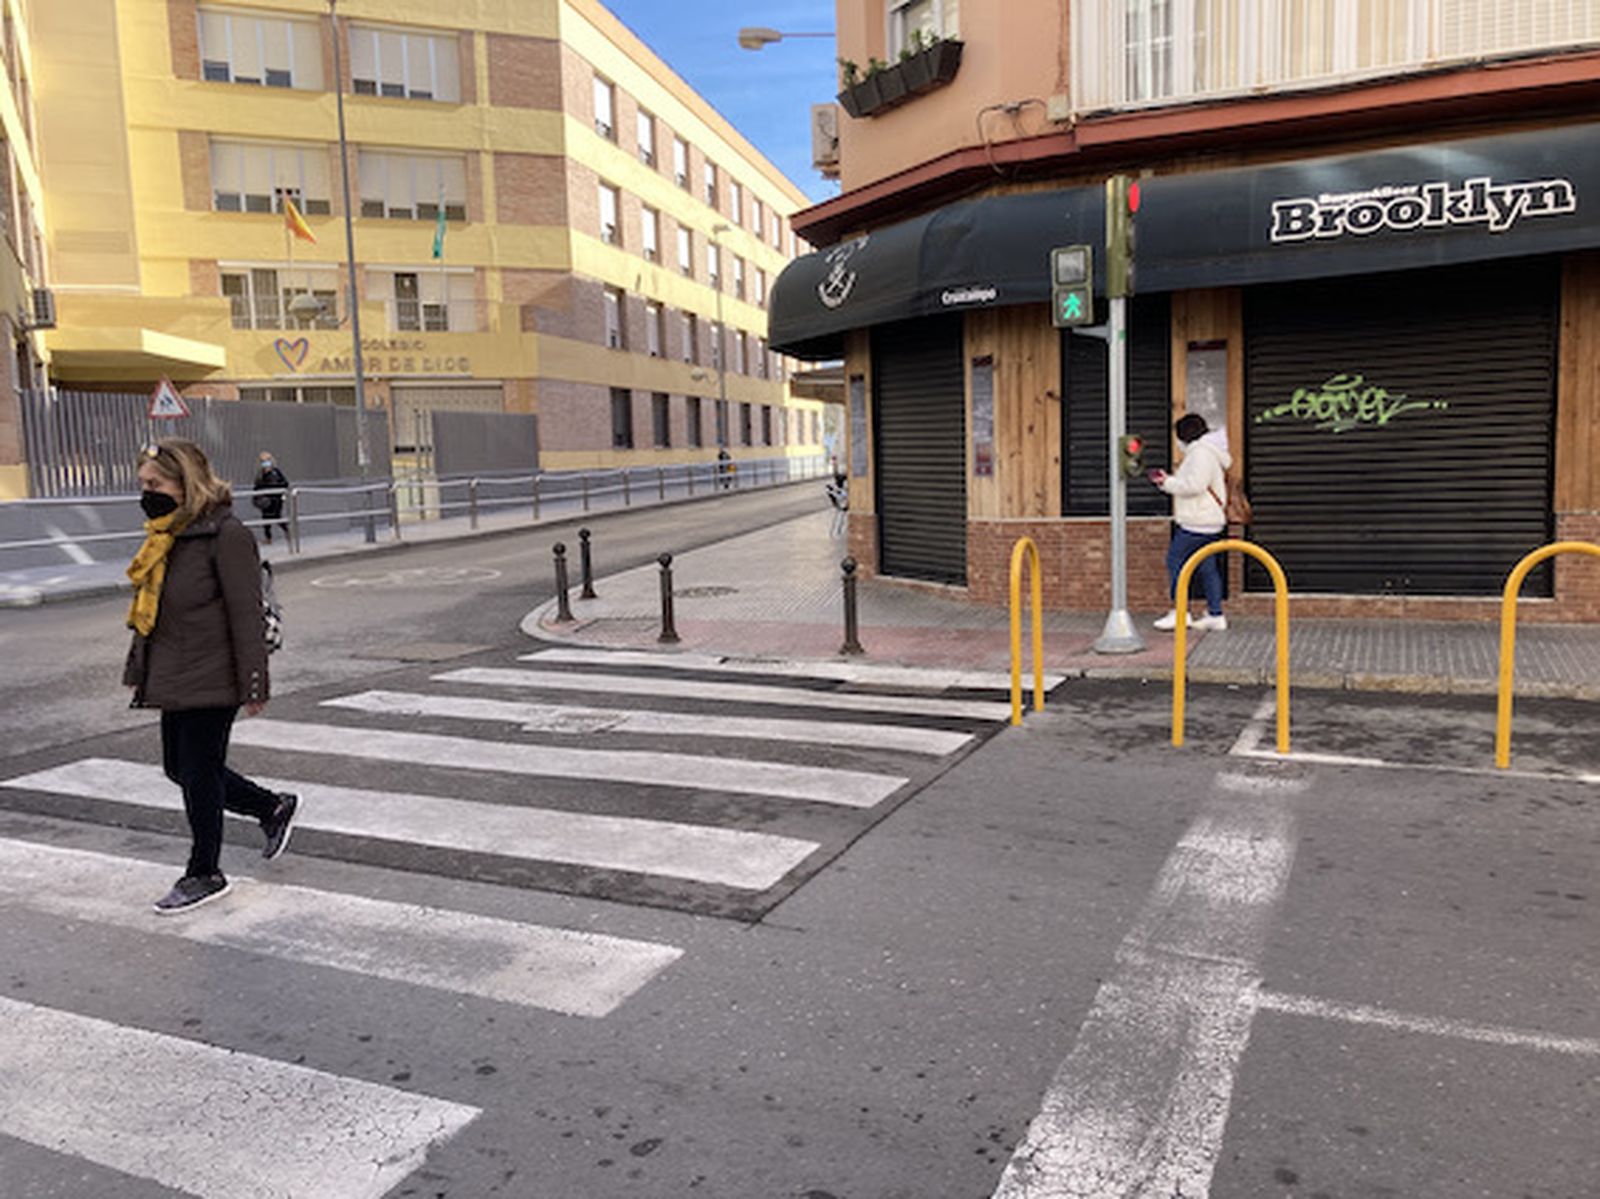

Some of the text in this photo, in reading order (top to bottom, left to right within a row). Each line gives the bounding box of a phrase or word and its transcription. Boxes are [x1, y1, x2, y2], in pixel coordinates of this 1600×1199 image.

[1271, 178, 1576, 242] Brooklyn
[320, 356, 382, 372] AMR
[389, 357, 416, 372] DE
